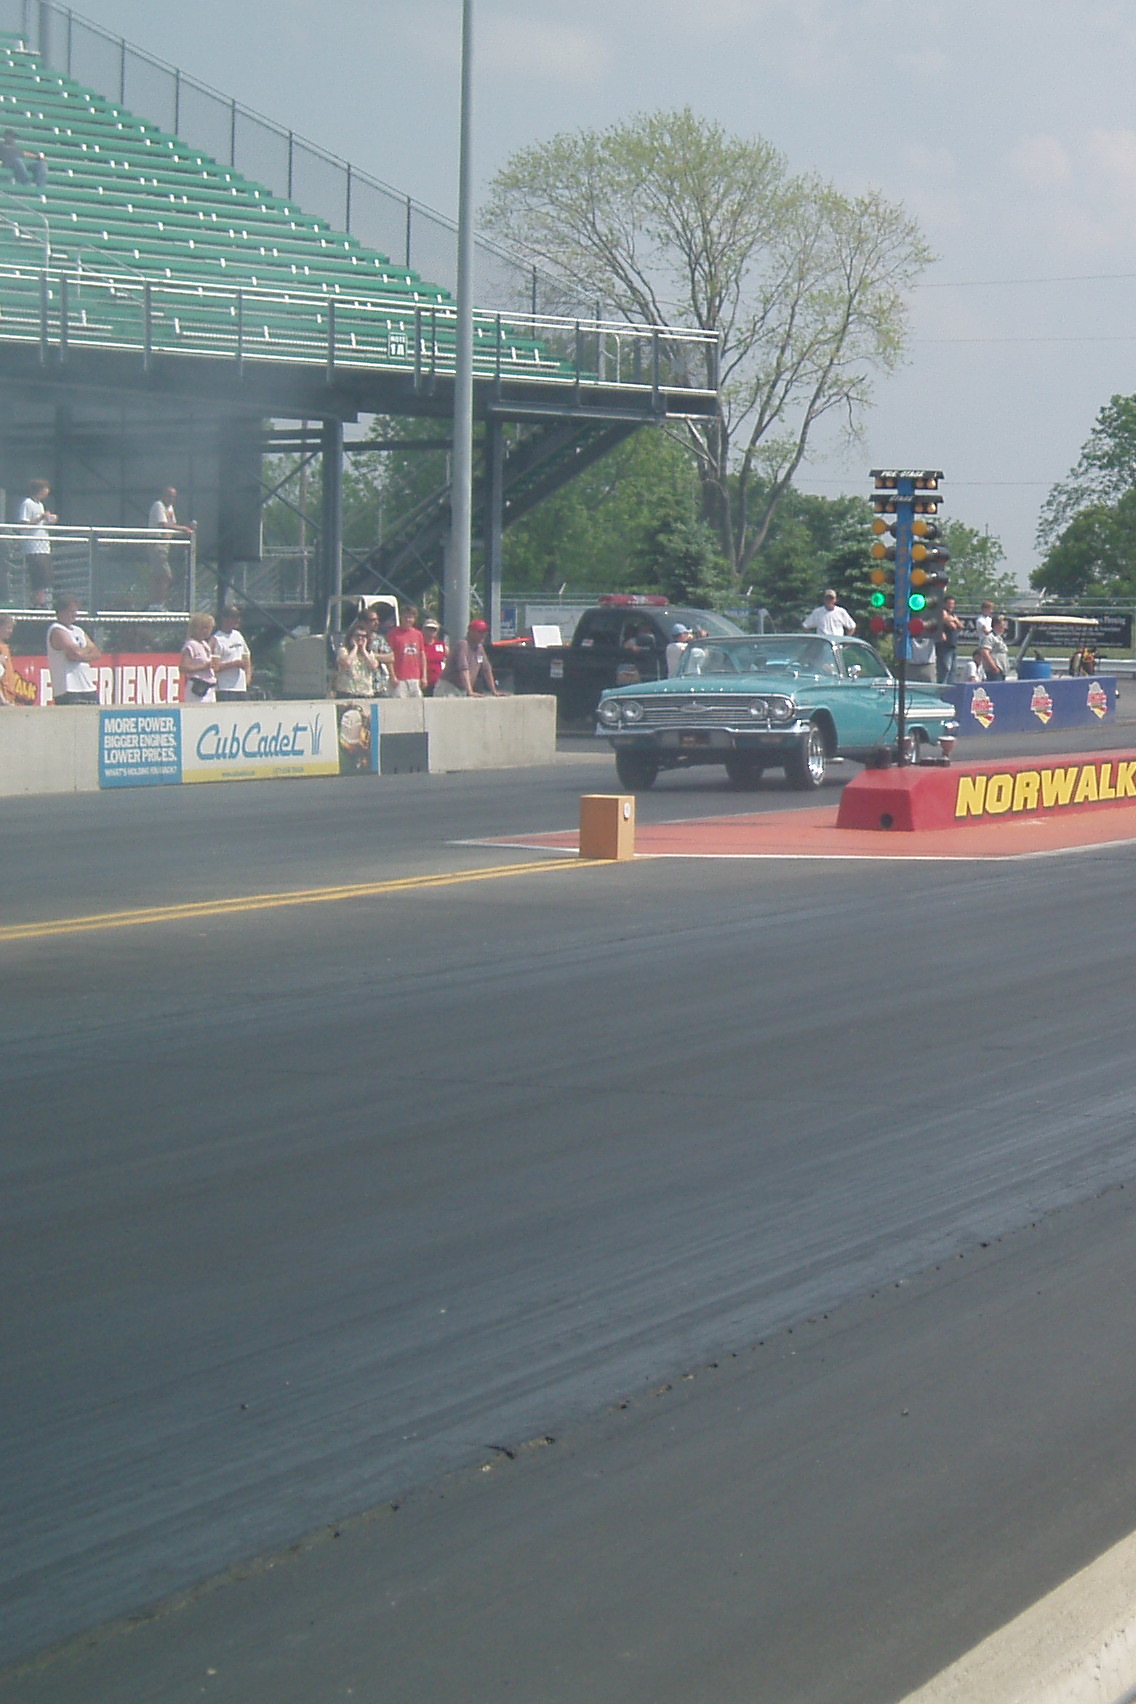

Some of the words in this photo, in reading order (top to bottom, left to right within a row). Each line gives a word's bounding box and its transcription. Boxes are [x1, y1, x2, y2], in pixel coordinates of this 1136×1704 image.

[40, 665, 180, 706] EERIENCE
[104, 718, 137, 733] MORE
[138, 716, 176, 732] POWER.
[104, 735, 138, 749] BIGGER
[196, 722, 240, 760] Cub
[241, 720, 308, 759] Cadet
[104, 749, 140, 764] LOWER
[142, 747, 176, 762] PRICES.
